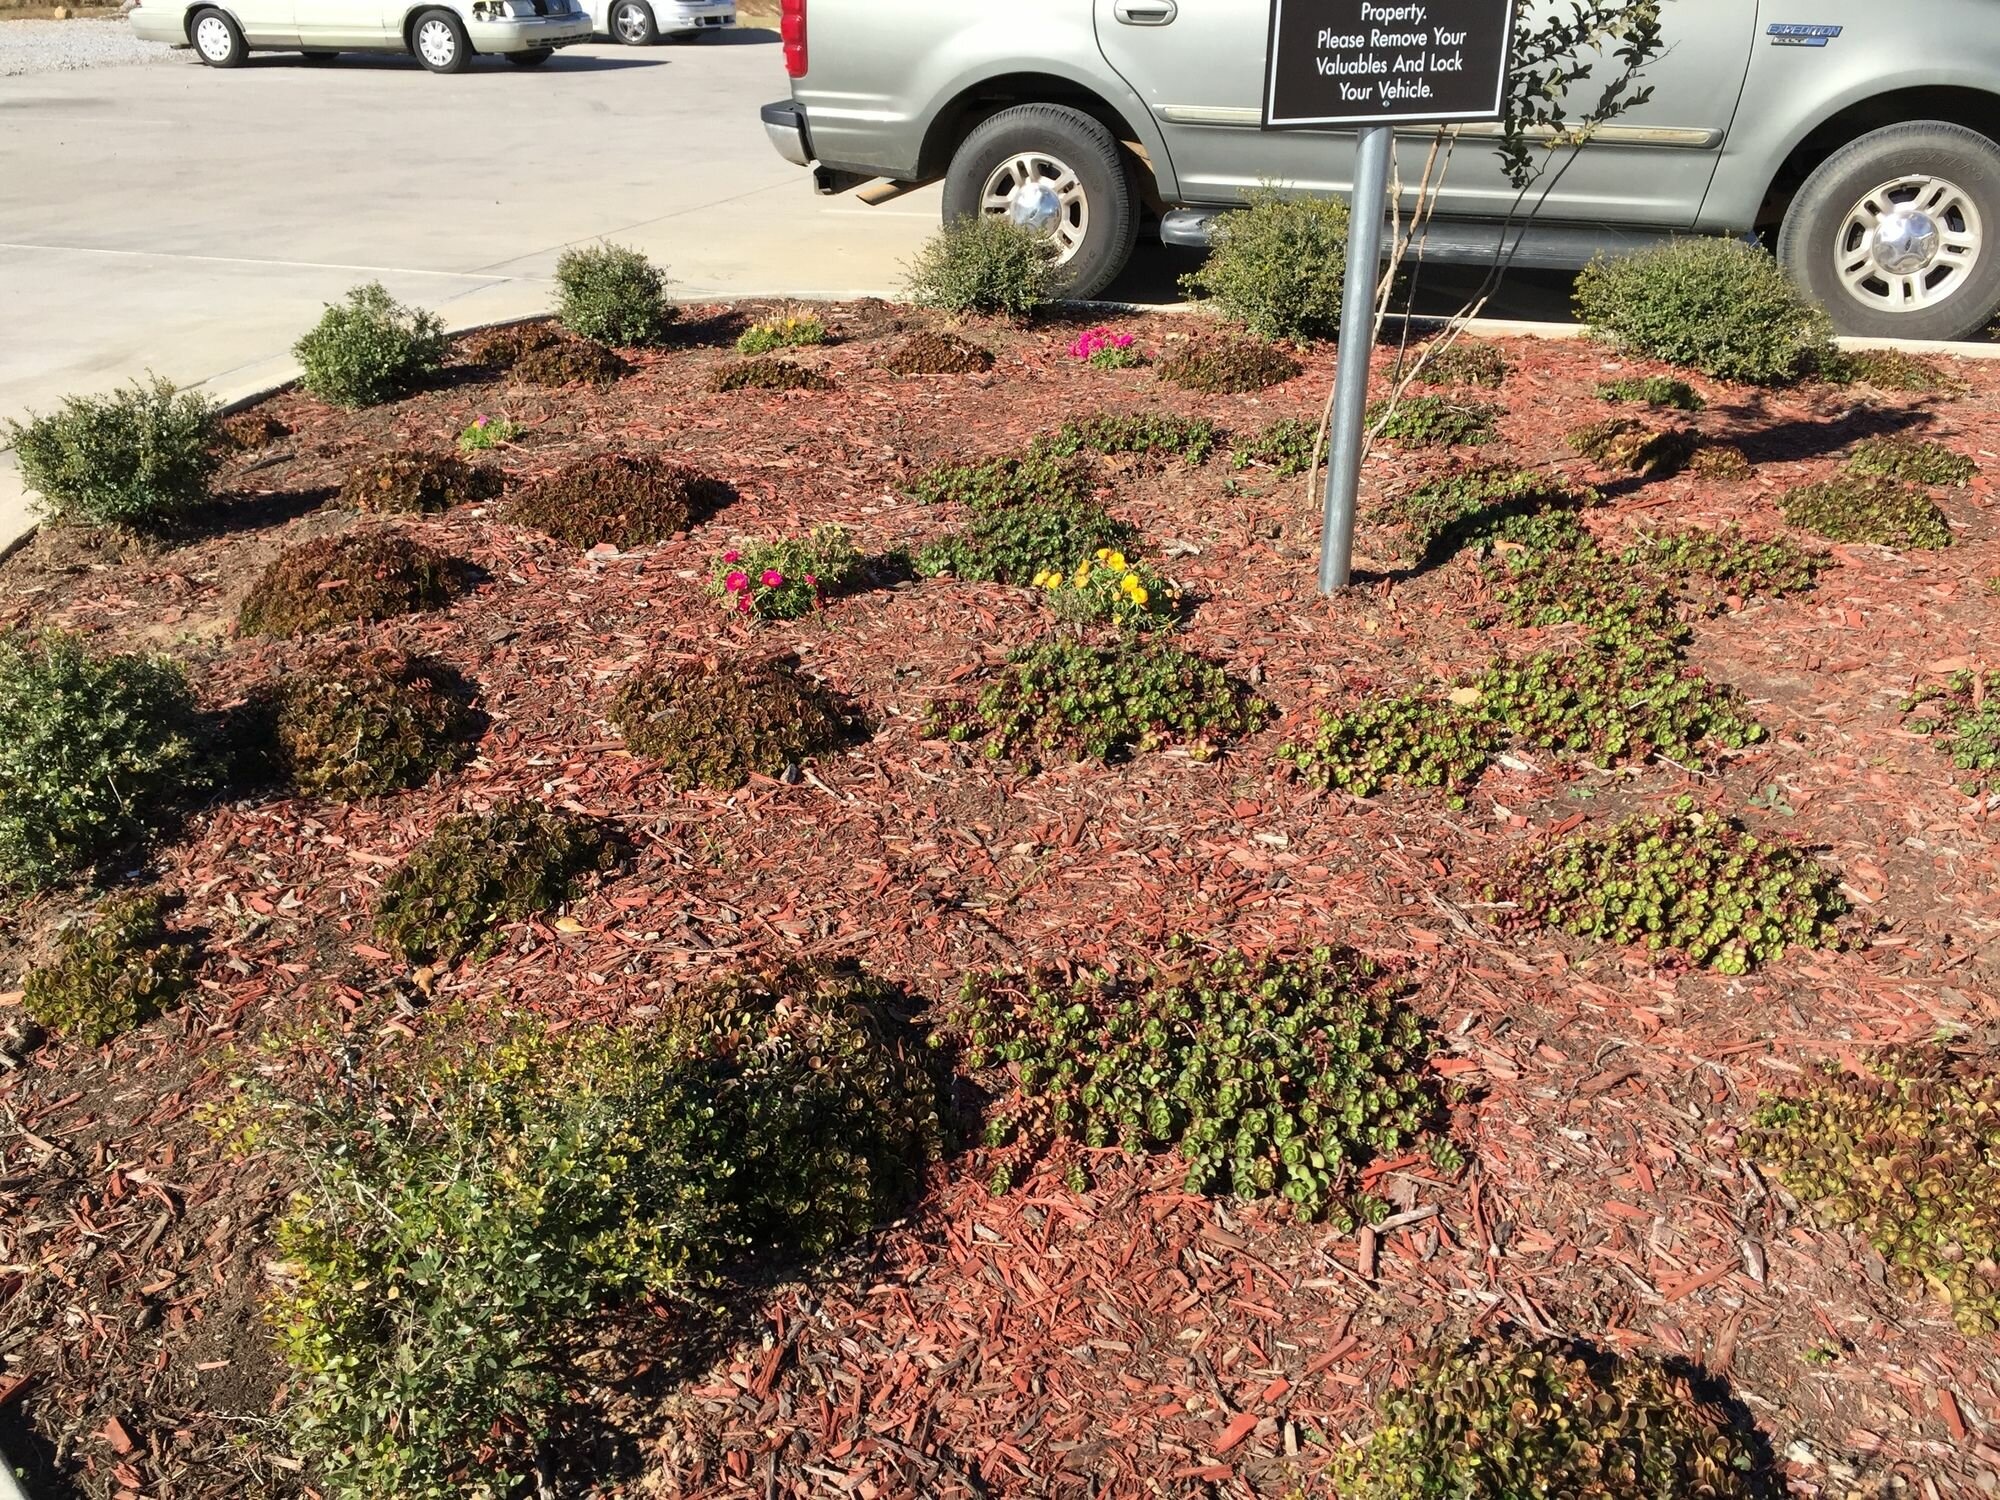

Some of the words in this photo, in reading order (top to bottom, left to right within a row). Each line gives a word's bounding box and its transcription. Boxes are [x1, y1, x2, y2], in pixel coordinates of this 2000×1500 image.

[1360, 1, 1427, 27] Property.
[1317, 27, 1365, 49] Please
[1370, 28, 1428, 48] Remove
[1433, 26, 1467, 46] Your
[1767, 24, 1841, 36] EXPEDITION
[1315, 53, 1388, 76] Valuables
[1391, 50, 1426, 73] And
[1429, 49, 1464, 72] Lock
[1339, 81, 1374, 101] Your
[1378, 76, 1434, 100] Vehicle.
